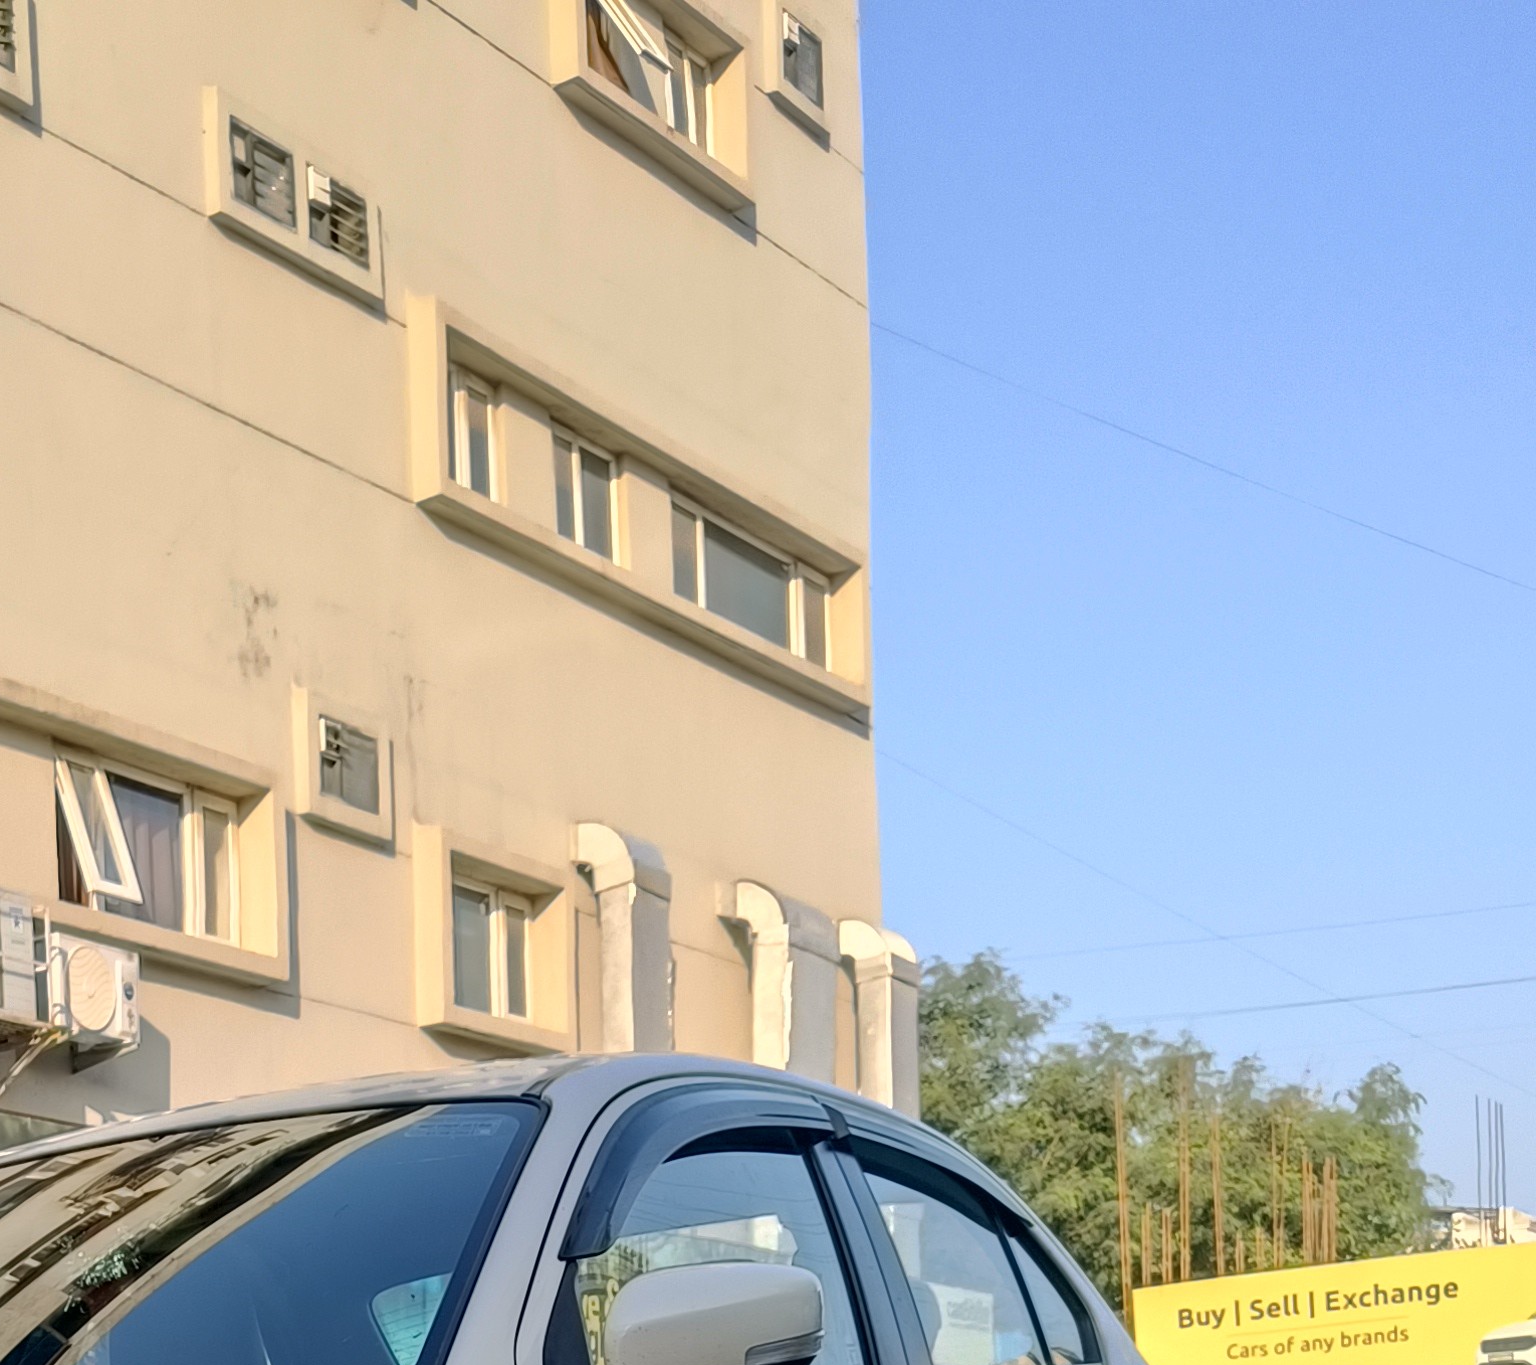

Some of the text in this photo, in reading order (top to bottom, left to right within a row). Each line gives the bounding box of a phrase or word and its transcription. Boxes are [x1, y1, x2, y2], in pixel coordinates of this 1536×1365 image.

[1177, 1307, 1227, 1330] Buy
[1249, 1293, 1300, 1321] Sell
[1325, 1281, 1460, 1313] Exchange
[1226, 1325, 1409, 1360] Cars of any brands
